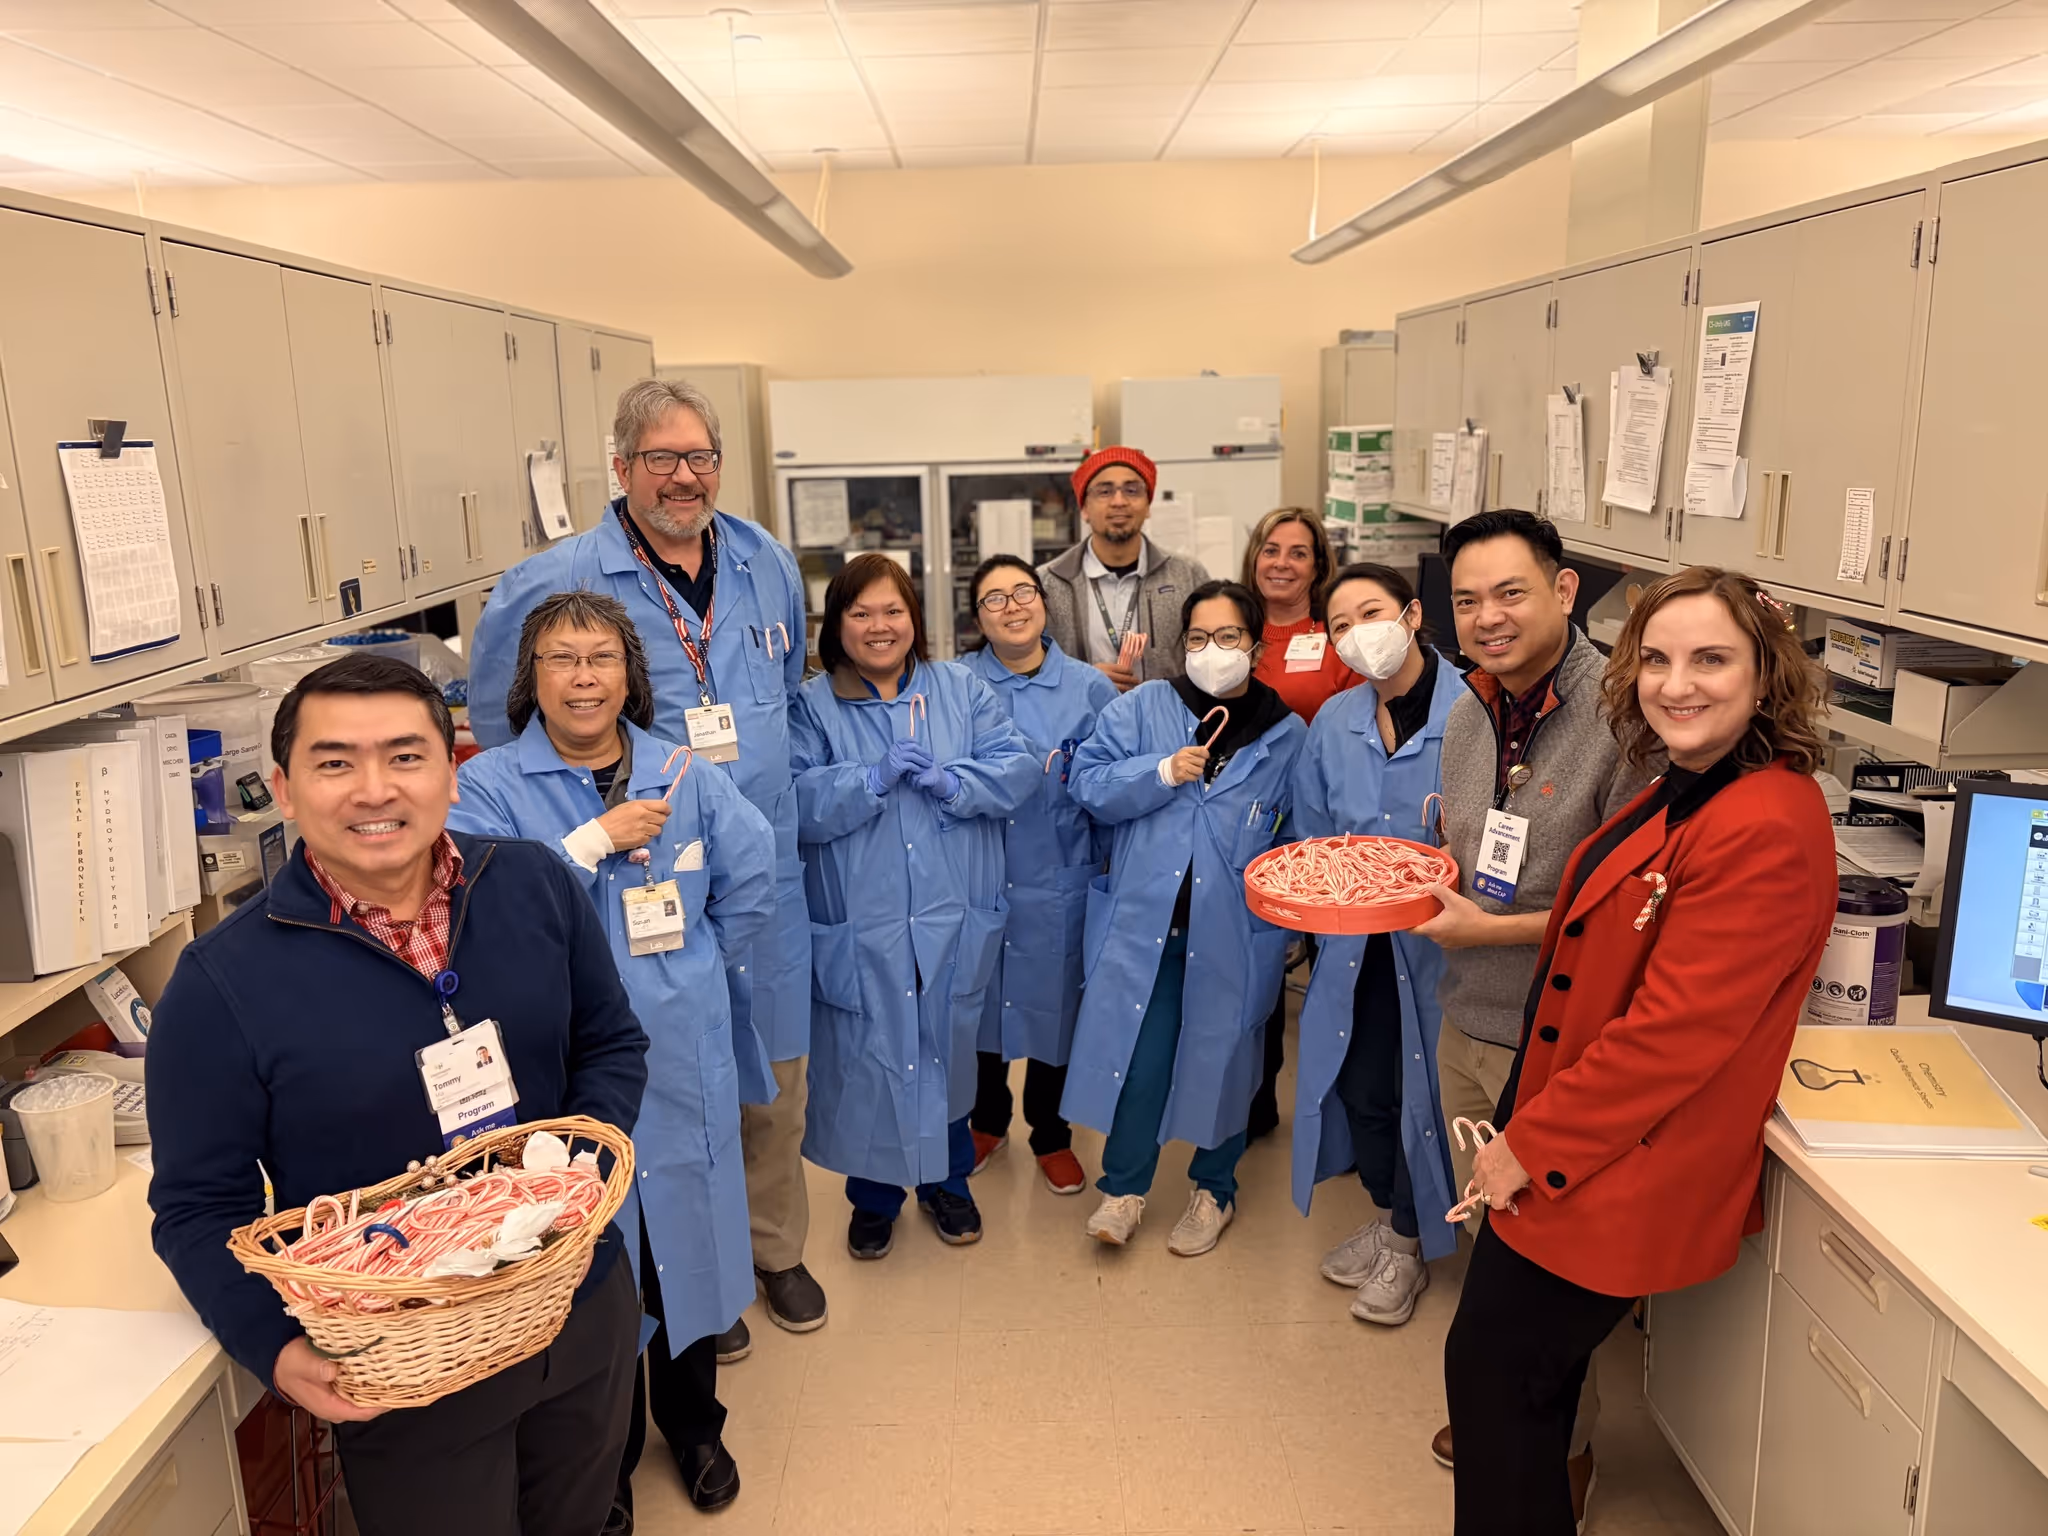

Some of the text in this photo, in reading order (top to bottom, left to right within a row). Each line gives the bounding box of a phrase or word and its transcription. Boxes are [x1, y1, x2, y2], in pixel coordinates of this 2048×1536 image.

[1498, 821, 1514, 832] Career
[1489, 827, 1520, 842] Advancement
[103, 789, 119, 929] HYDROXYBUTYRATE
[76, 832, 85, 922] FIBRONECTIN
[1487, 864, 1508, 877] Program
[1497, 889, 1507, 898] CAP
[1833, 926, 1870, 937] Sani-Cloth
[650, 941, 664, 950] Lab
[433, 1074, 462, 1092] Tommy
[1918, 1062, 1948, 1097] Chemistry
[458, 1099, 495, 1121] Program
[471, 1126, 485, 1136] Ask
[485, 1122, 496, 1131] me
